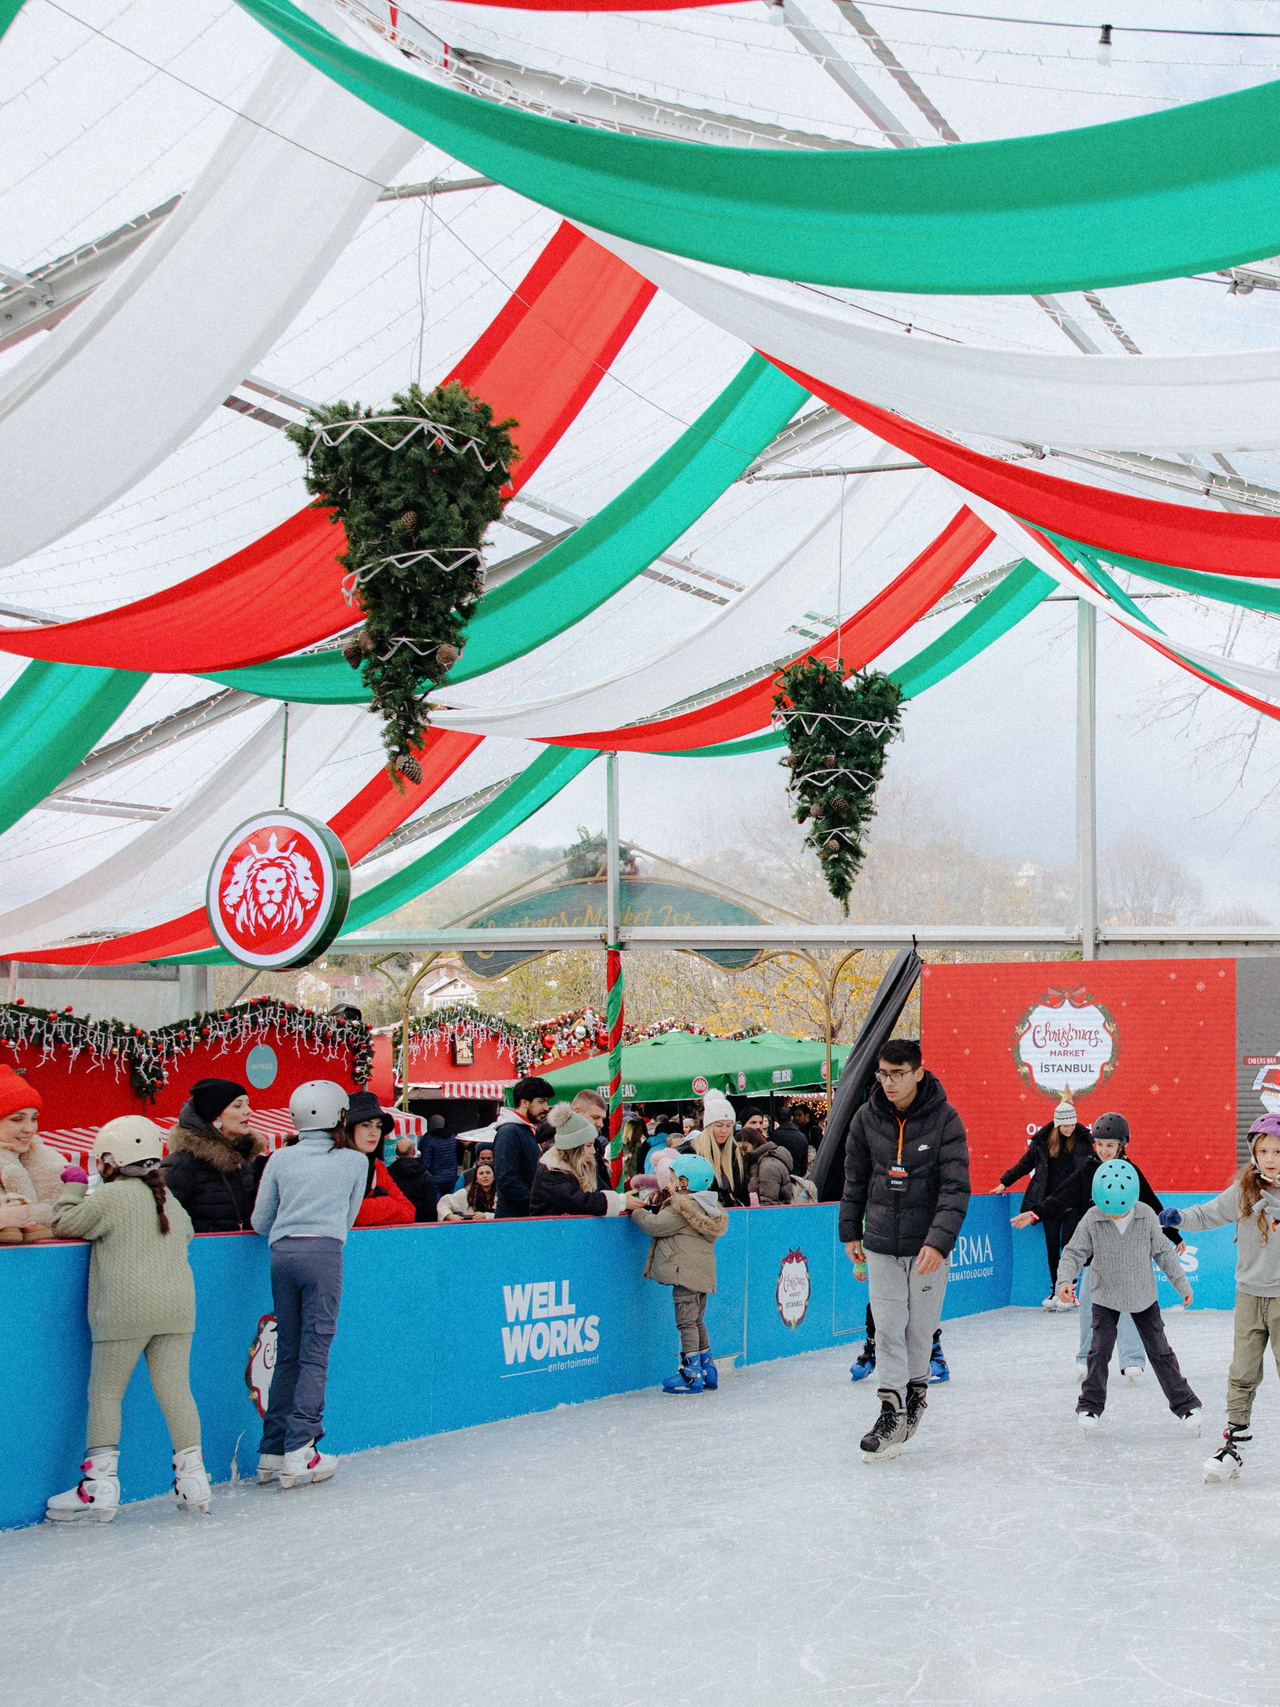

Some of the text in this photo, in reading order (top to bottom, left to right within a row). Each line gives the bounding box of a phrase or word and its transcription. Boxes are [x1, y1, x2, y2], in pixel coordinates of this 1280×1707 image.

[1032, 1021, 1103, 1049] Christmas
[1049, 1049, 1086, 1057] MARKET
[1247, 1057, 1277, 1065] CHEERS BAR
[1040, 1062, 1095, 1073] İSTANBUL
[950, 1233, 993, 1268] ERMA
[948, 1266, 994, 1282] ERMATOLOGIQUE
[503, 1280, 576, 1323] WELL
[501, 1315, 600, 1366] WORKS
[547, 1355, 600, 1373] entertainment
